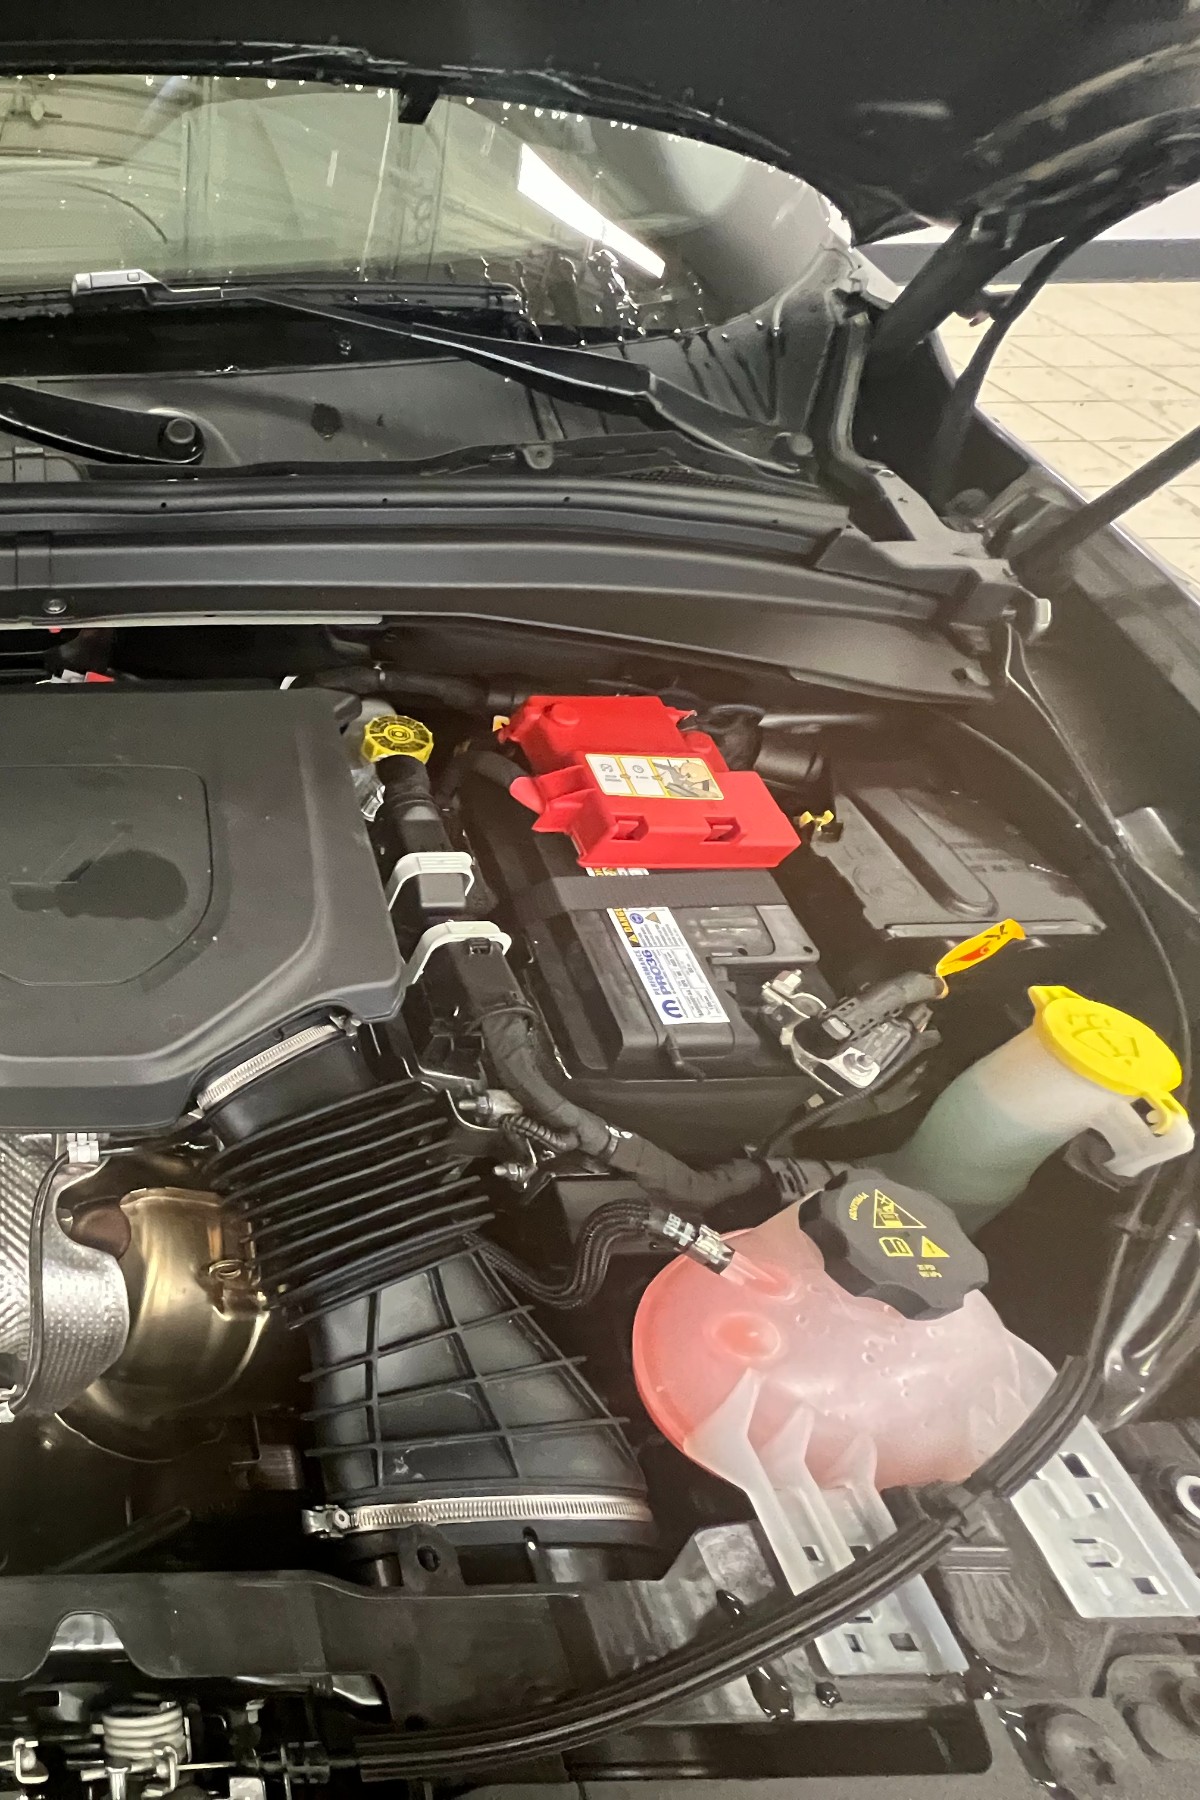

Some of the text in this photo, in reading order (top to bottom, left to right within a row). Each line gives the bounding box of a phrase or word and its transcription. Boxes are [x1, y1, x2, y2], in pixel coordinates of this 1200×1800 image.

[614, 908, 634, 932] DANG
[633, 949, 661, 996] PERFORMANCE
[642, 949, 672, 995] PRO36
